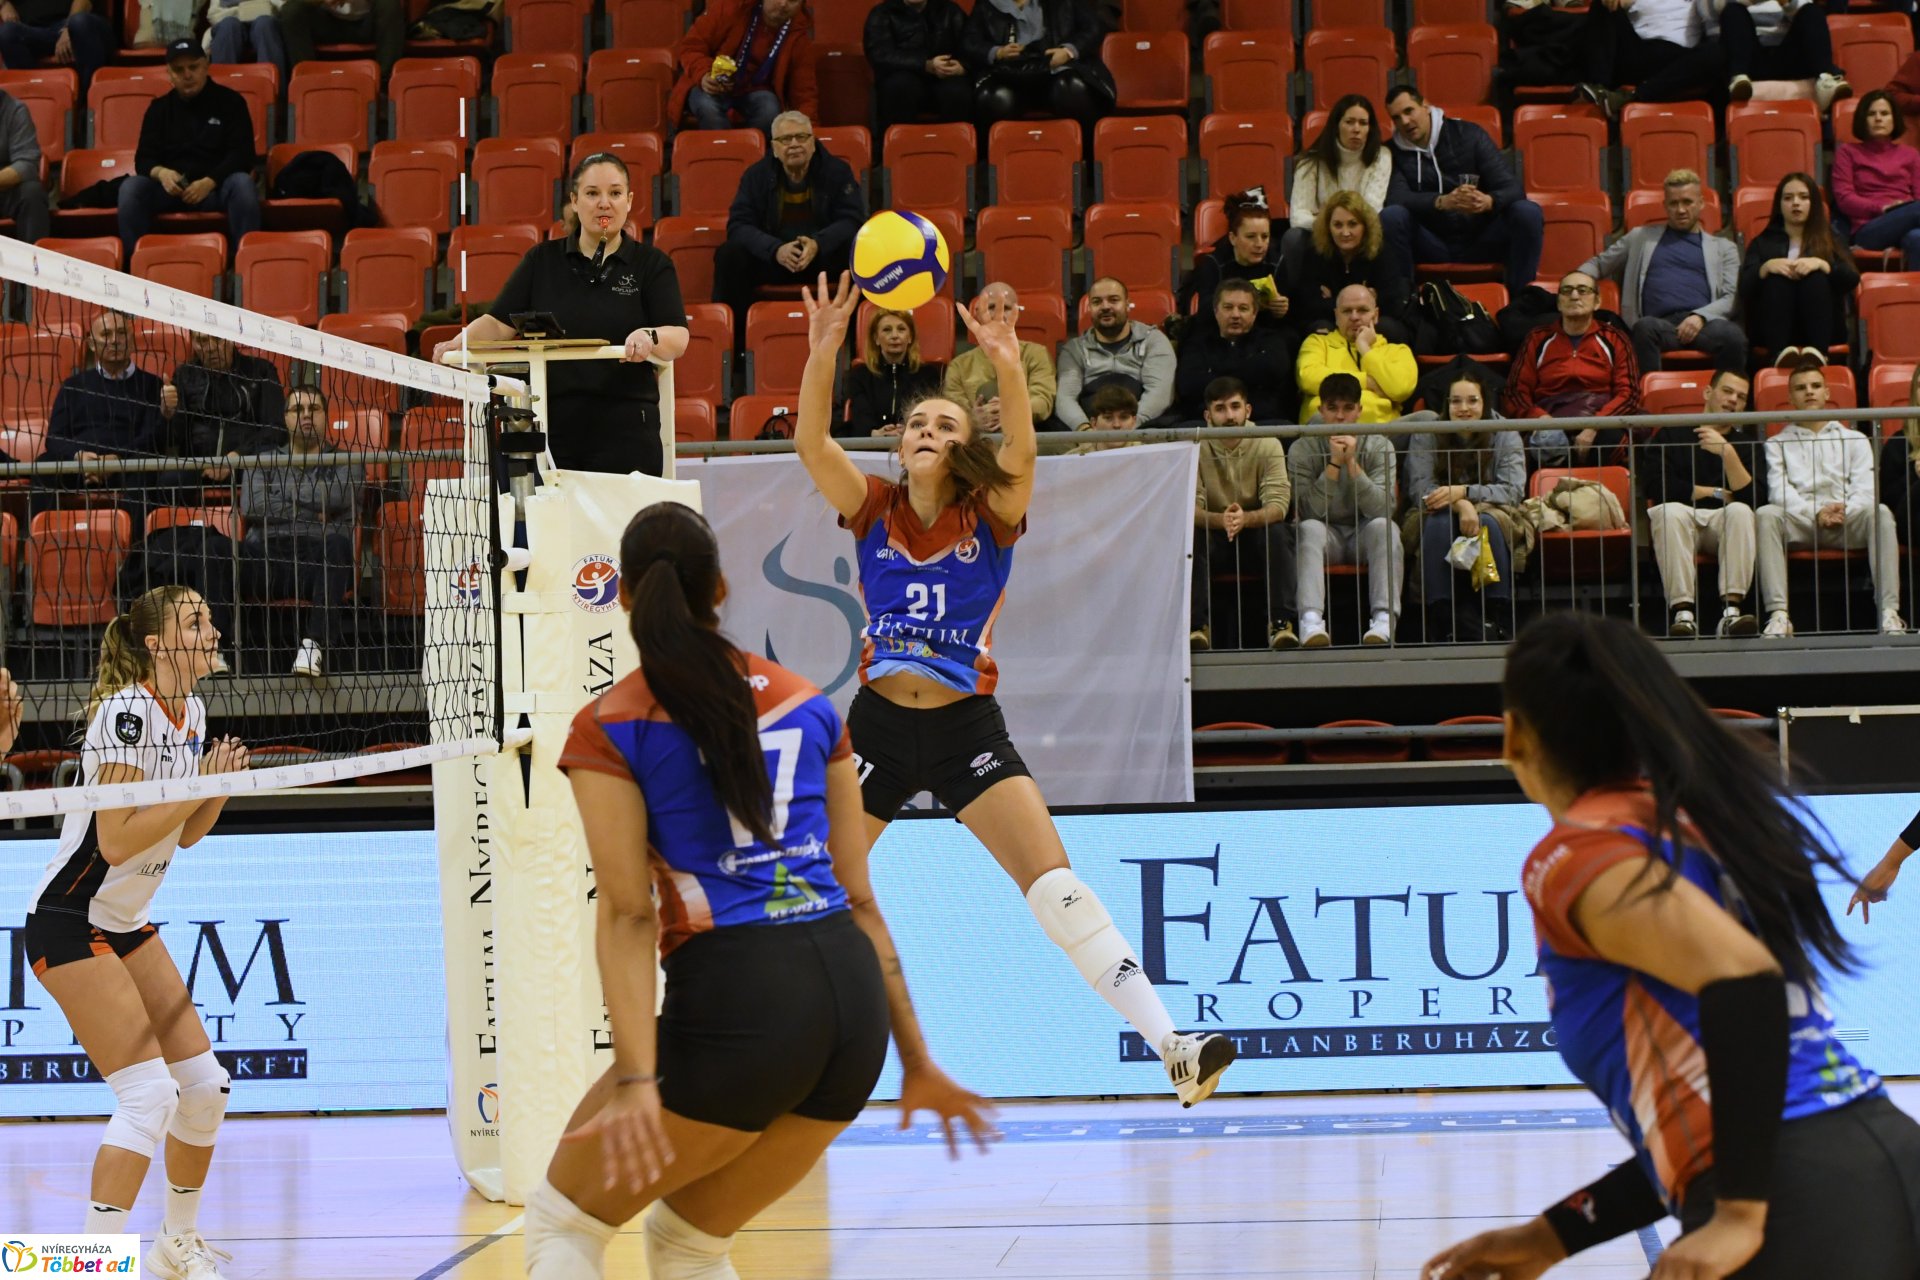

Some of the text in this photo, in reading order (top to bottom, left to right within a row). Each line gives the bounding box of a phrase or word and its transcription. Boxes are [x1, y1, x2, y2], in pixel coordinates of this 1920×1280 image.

[583, 555, 613, 565] FATUM
[905, 582, 946, 622] 21
[1119, 843, 1541, 987] FATU
[1125, 985, 1518, 1025] ROPER
[1121, 1026, 1559, 1058] ITLANBERUHÁZÓ
[235, 1055, 306, 1076] KFT
